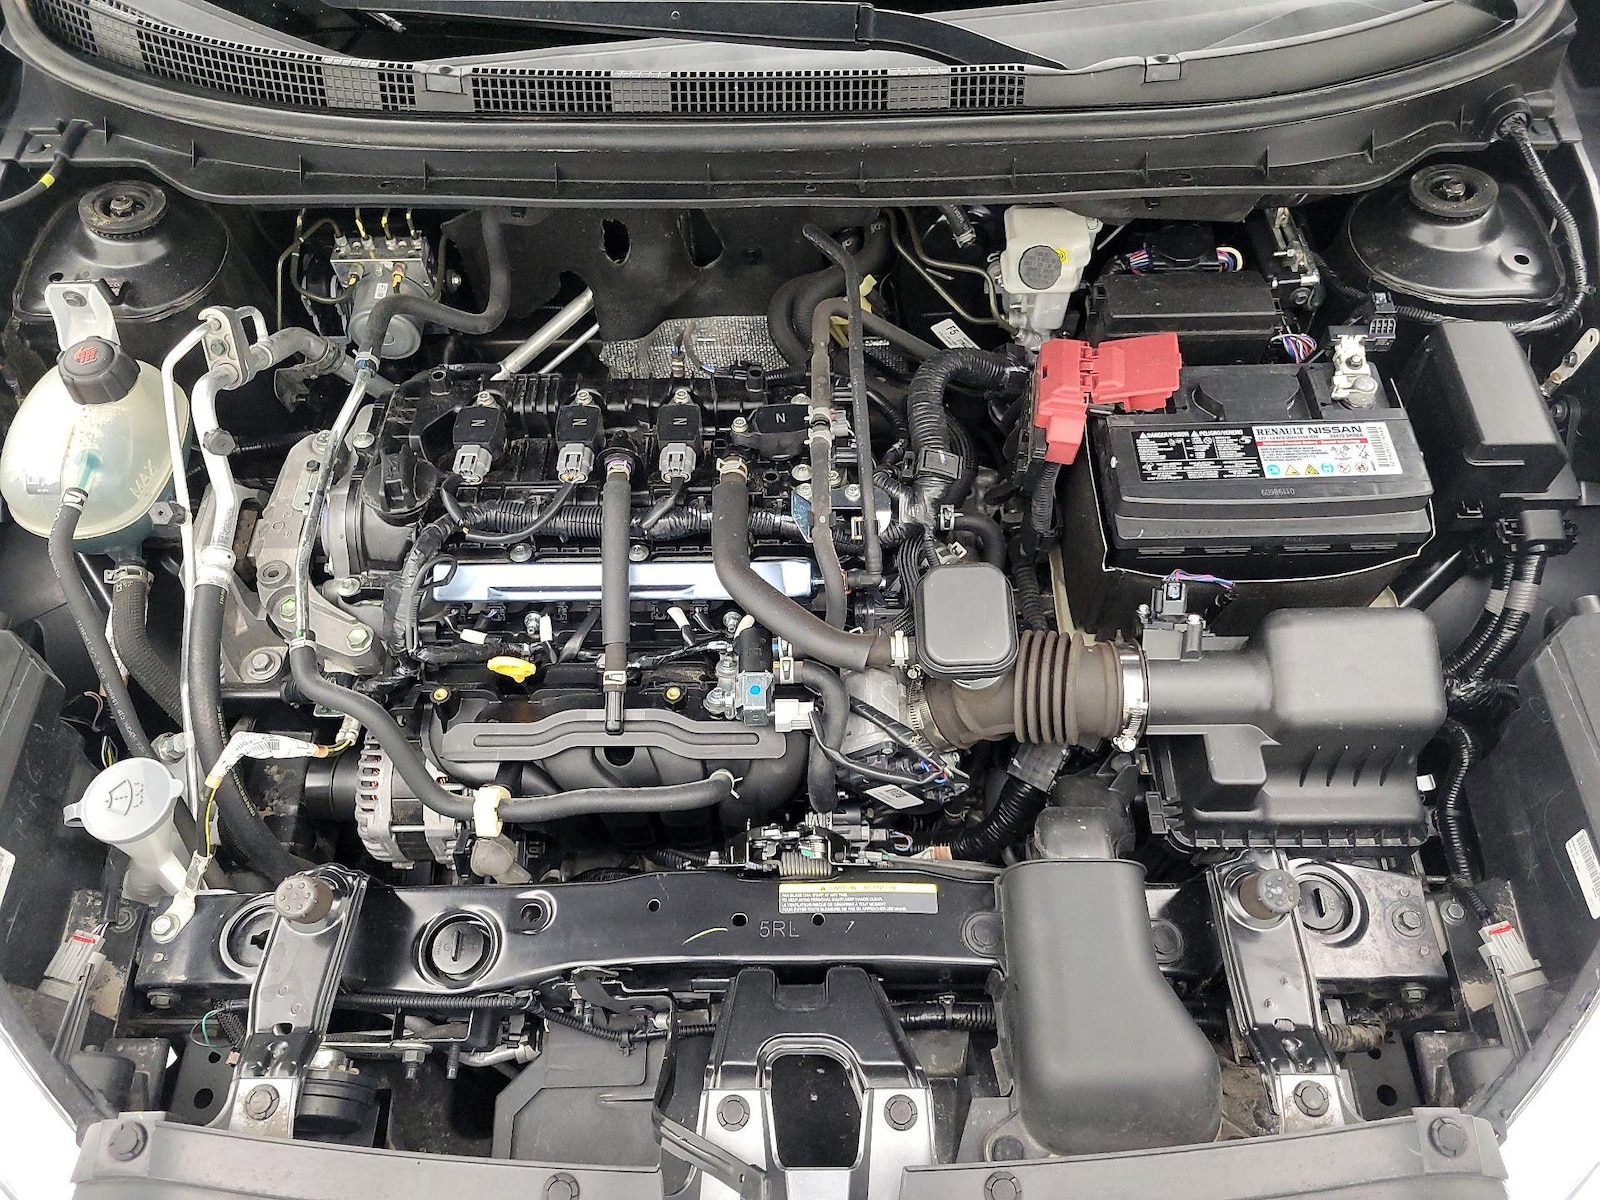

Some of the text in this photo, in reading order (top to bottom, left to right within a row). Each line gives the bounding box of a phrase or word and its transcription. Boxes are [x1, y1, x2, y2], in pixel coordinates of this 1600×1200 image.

[777, 412, 786, 423] N
[1256, 425, 1362, 436] RENAULT NISSAN
[129, 458, 153, 500] MAX
[759, 920, 800, 938] 5RL
